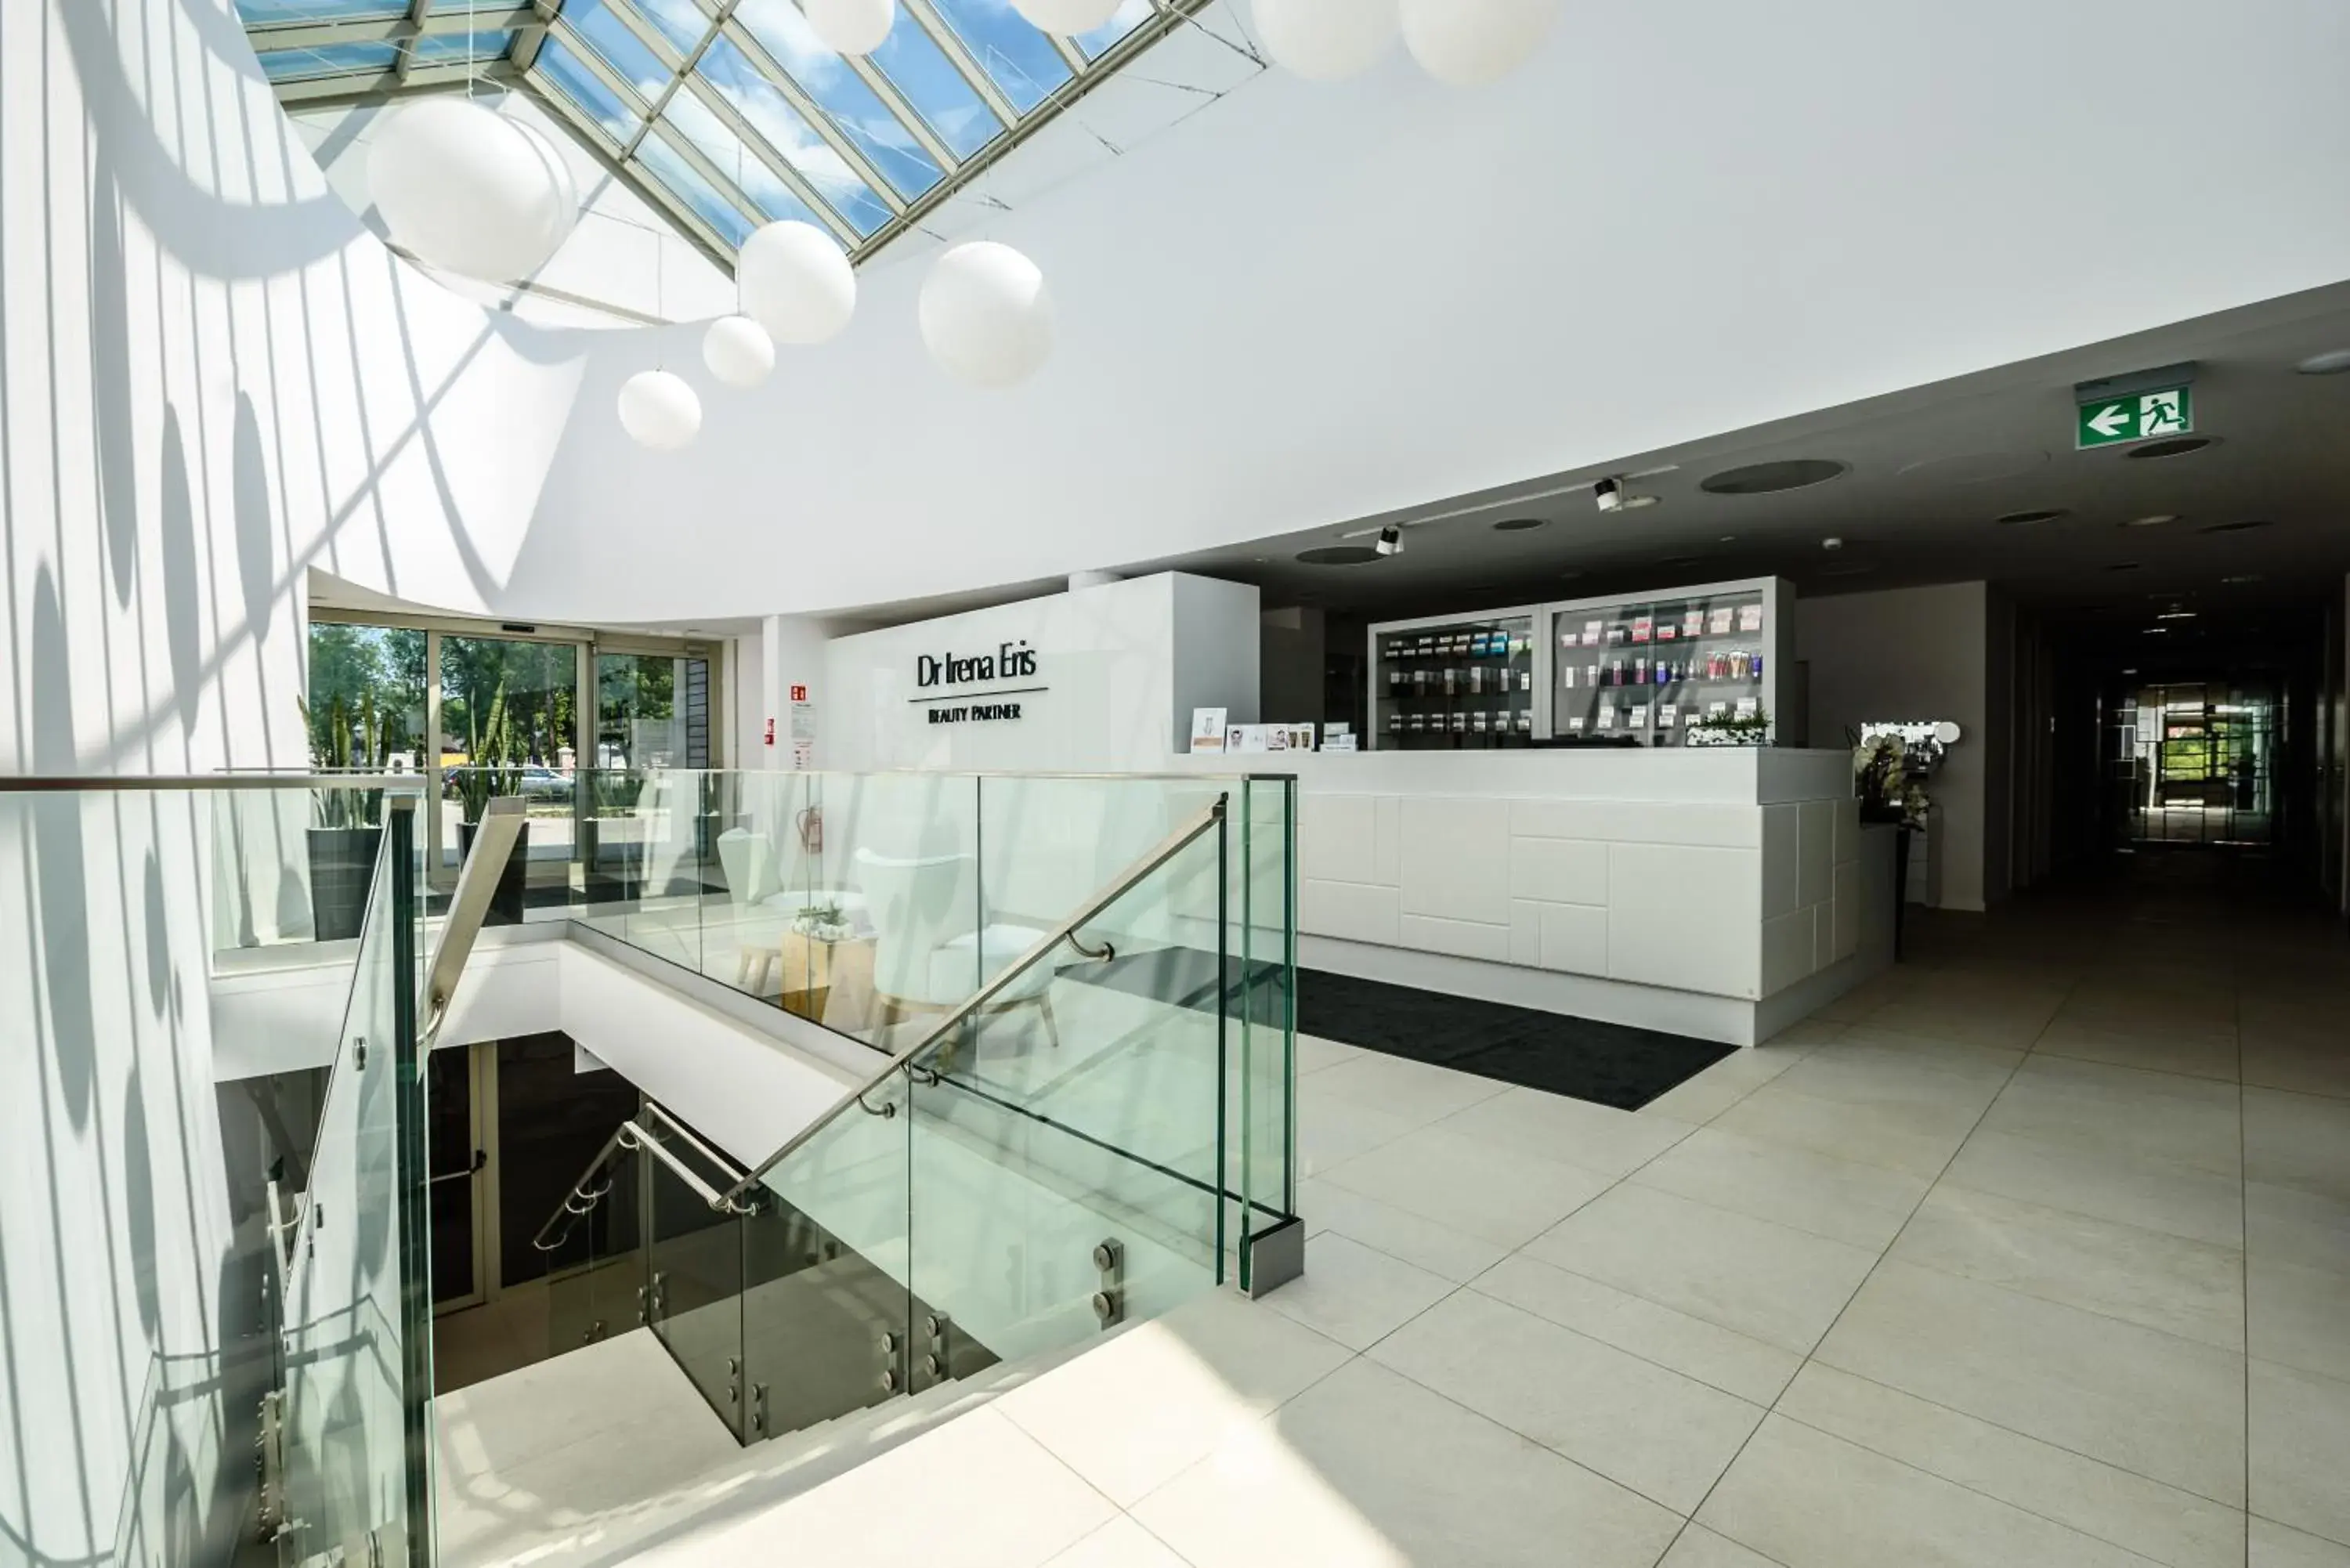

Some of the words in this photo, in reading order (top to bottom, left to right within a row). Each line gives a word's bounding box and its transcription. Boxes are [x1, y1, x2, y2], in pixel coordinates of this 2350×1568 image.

[917, 656, 942, 686] Dr
[945, 652, 995, 684] Irena
[1000, 640, 1036, 678] Eris
[928, 707, 968, 724] BEAUTY
[971, 703, 1021, 721] PARTNER
